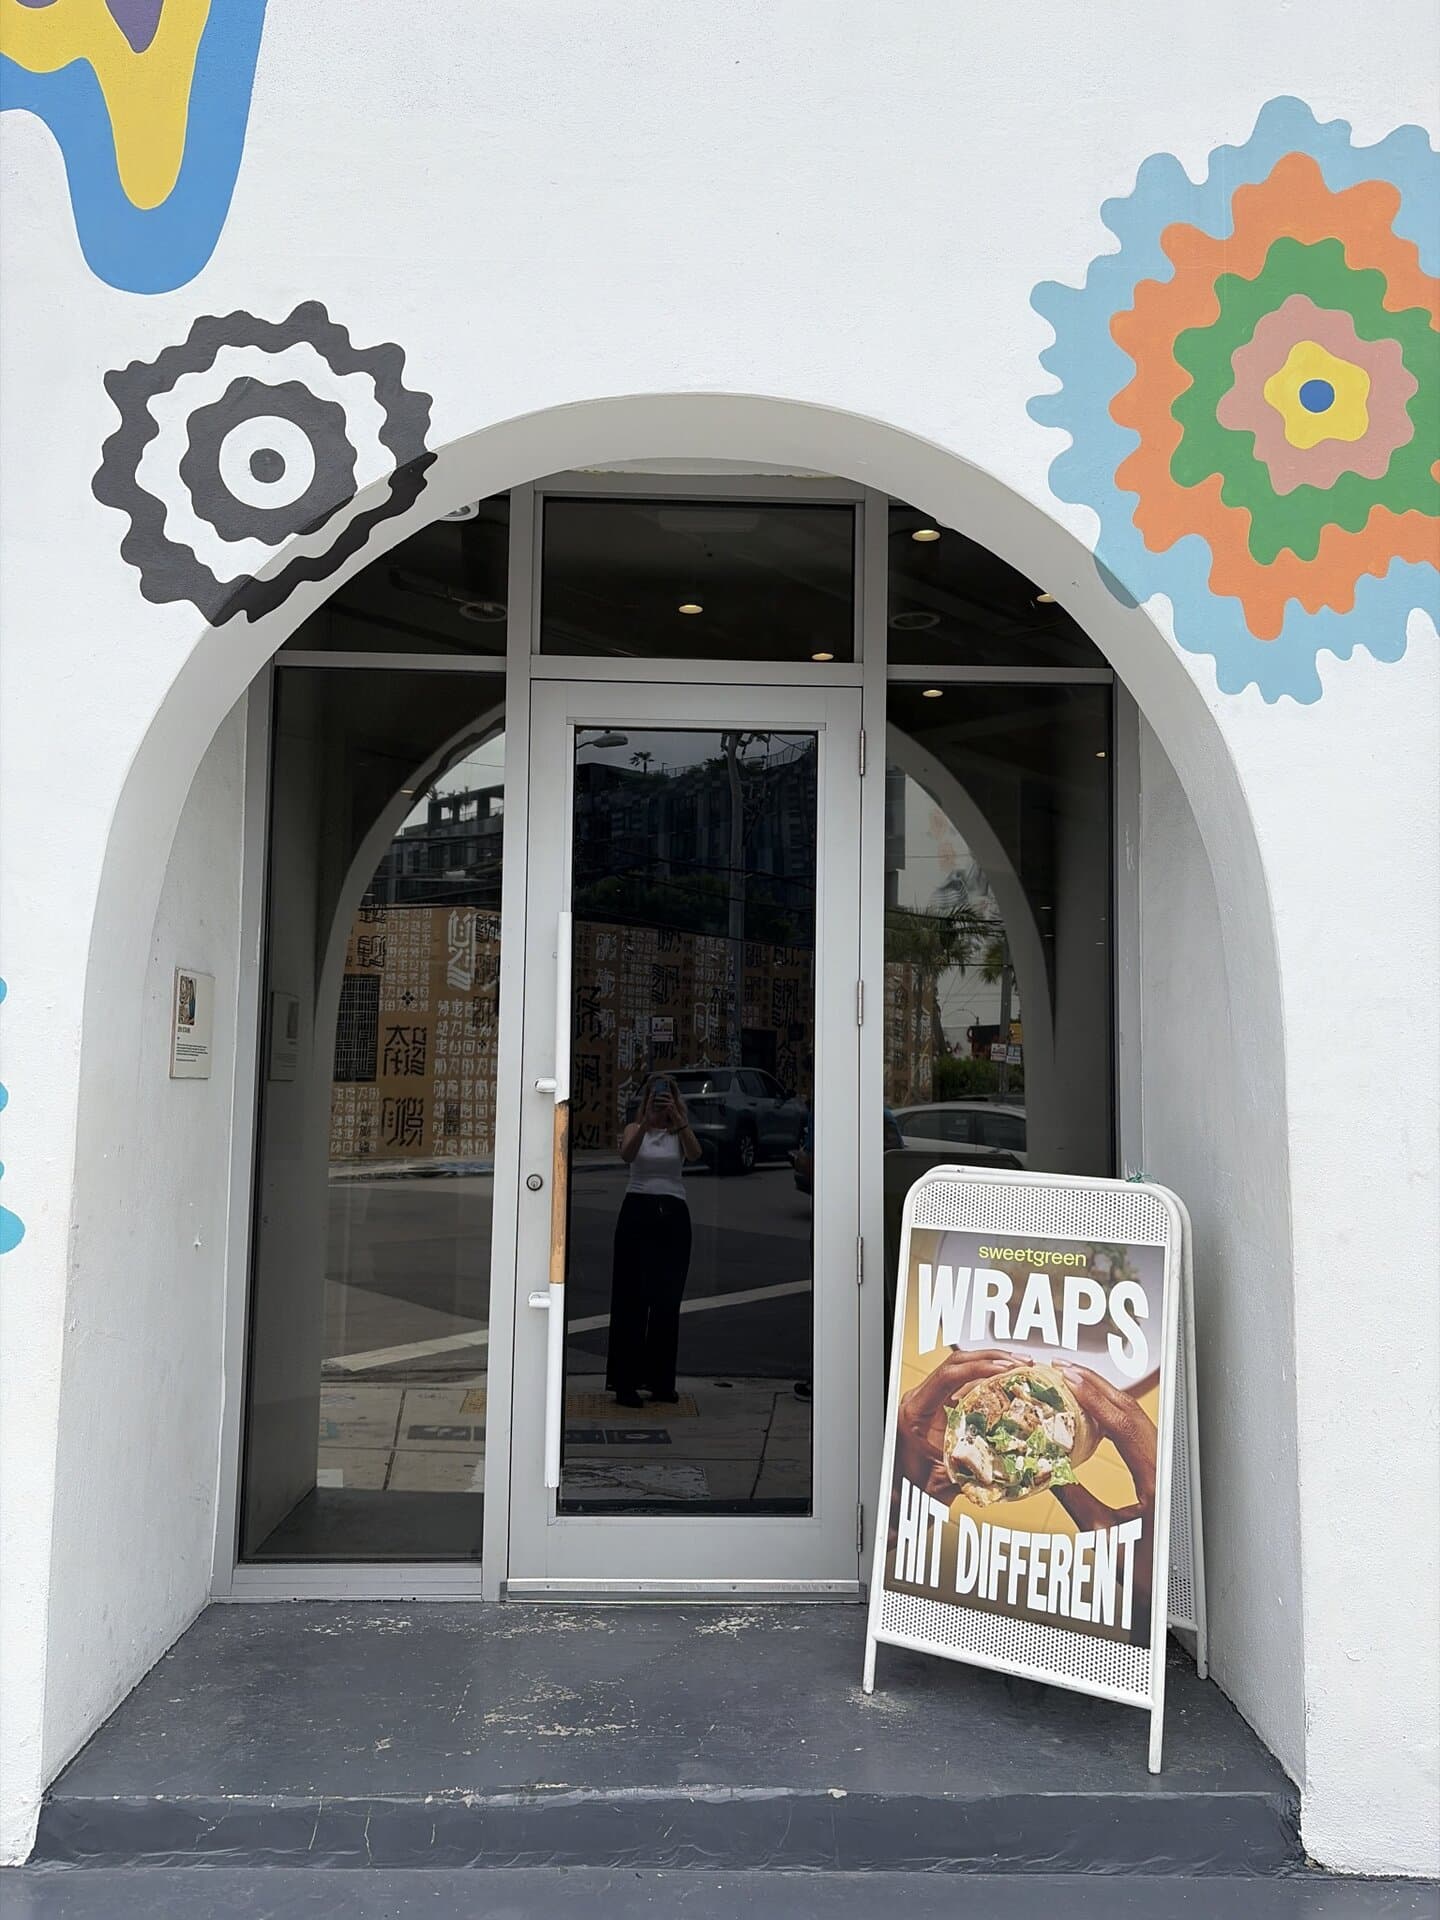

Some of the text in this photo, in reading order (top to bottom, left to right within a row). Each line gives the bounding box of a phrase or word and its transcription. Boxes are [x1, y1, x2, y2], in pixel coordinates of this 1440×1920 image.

[979, 1245, 1087, 1267] sweetgreen
[918, 1263, 1149, 1379] WRAPS
[895, 1477, 1142, 1630] HIT DIFFERENT
